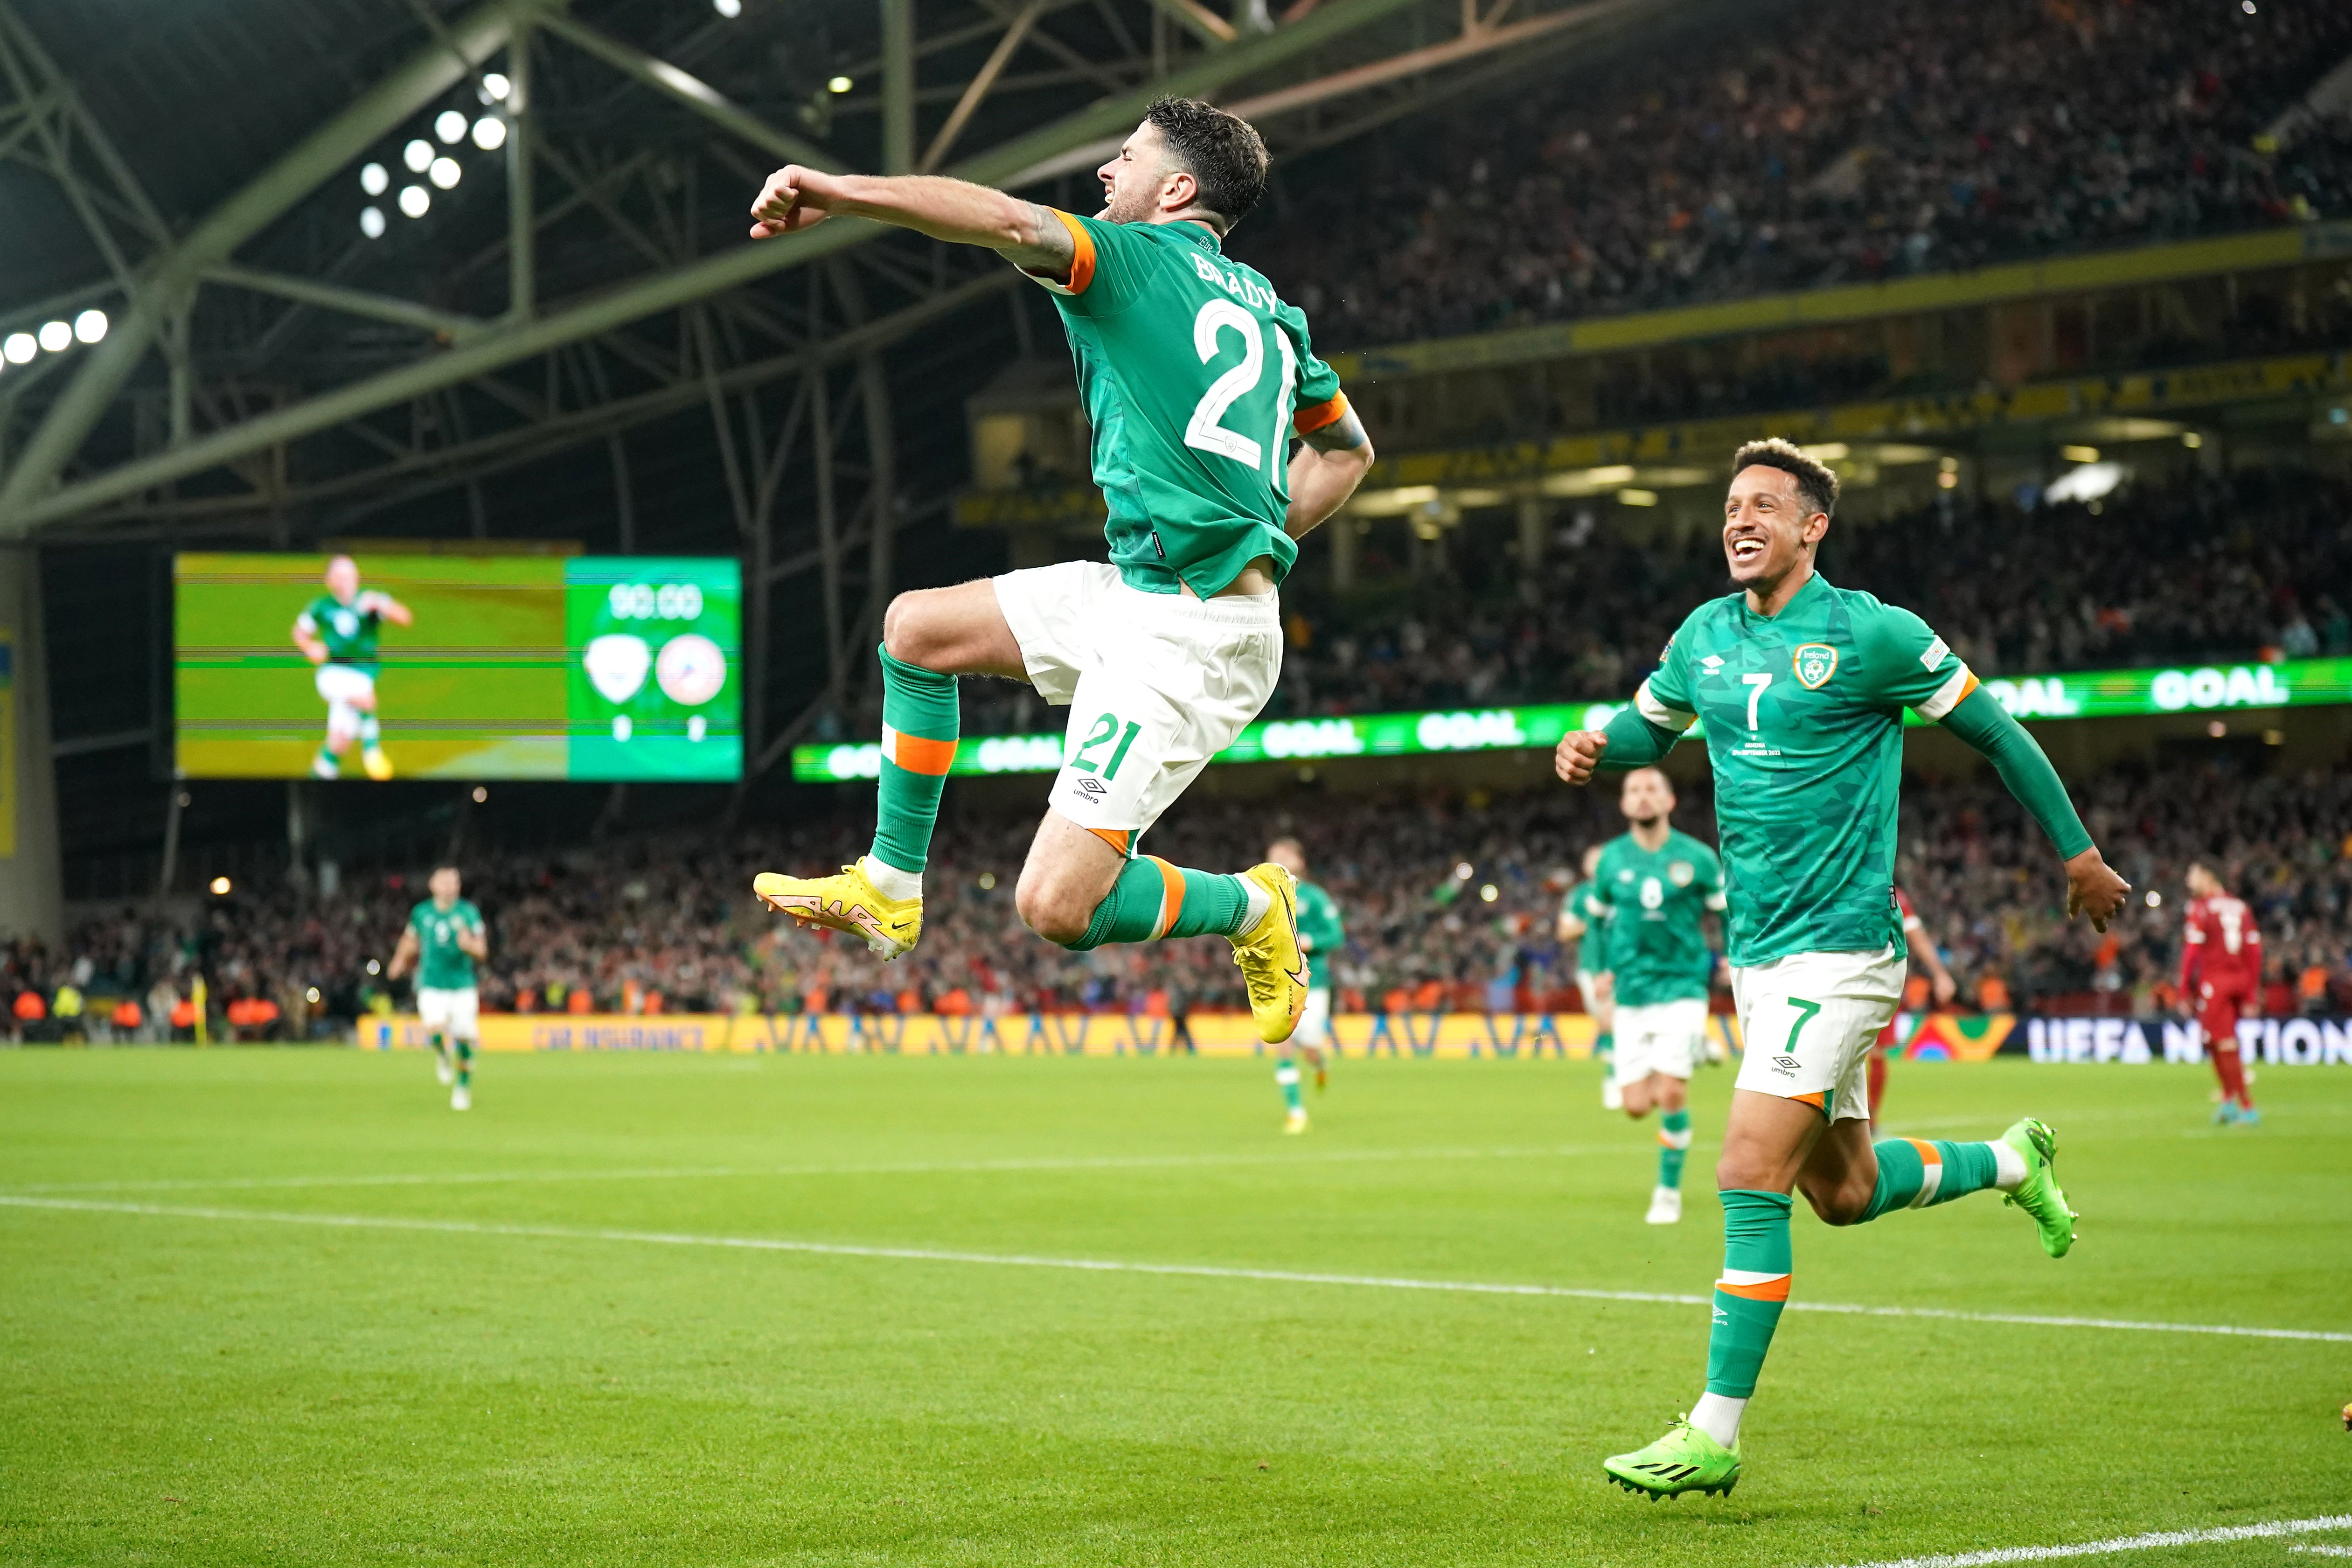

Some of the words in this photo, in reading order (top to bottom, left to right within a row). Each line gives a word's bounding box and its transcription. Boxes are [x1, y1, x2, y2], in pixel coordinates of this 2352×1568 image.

[1190, 251, 1277, 315] BRADY
[1183, 298, 1296, 490] 21
[1804, 650, 1830, 660] Ireland
[1742, 673, 1773, 731] 7
[1983, 678, 2079, 718] OAL
[2152, 665, 2290, 710] GOAL
[1070, 713, 1141, 781] 21
[1261, 719, 1364, 758] GOAL
[1417, 709, 1525, 750] GOAL
[828, 744, 882, 779] GO
[1073, 789, 1099, 804] umbro
[1785, 997, 1822, 1054] 7
[2027, 1017, 2153, 1064] UEFA
[2162, 1016, 2352, 1066] NTION
[1771, 1067, 1795, 1078] umbro
